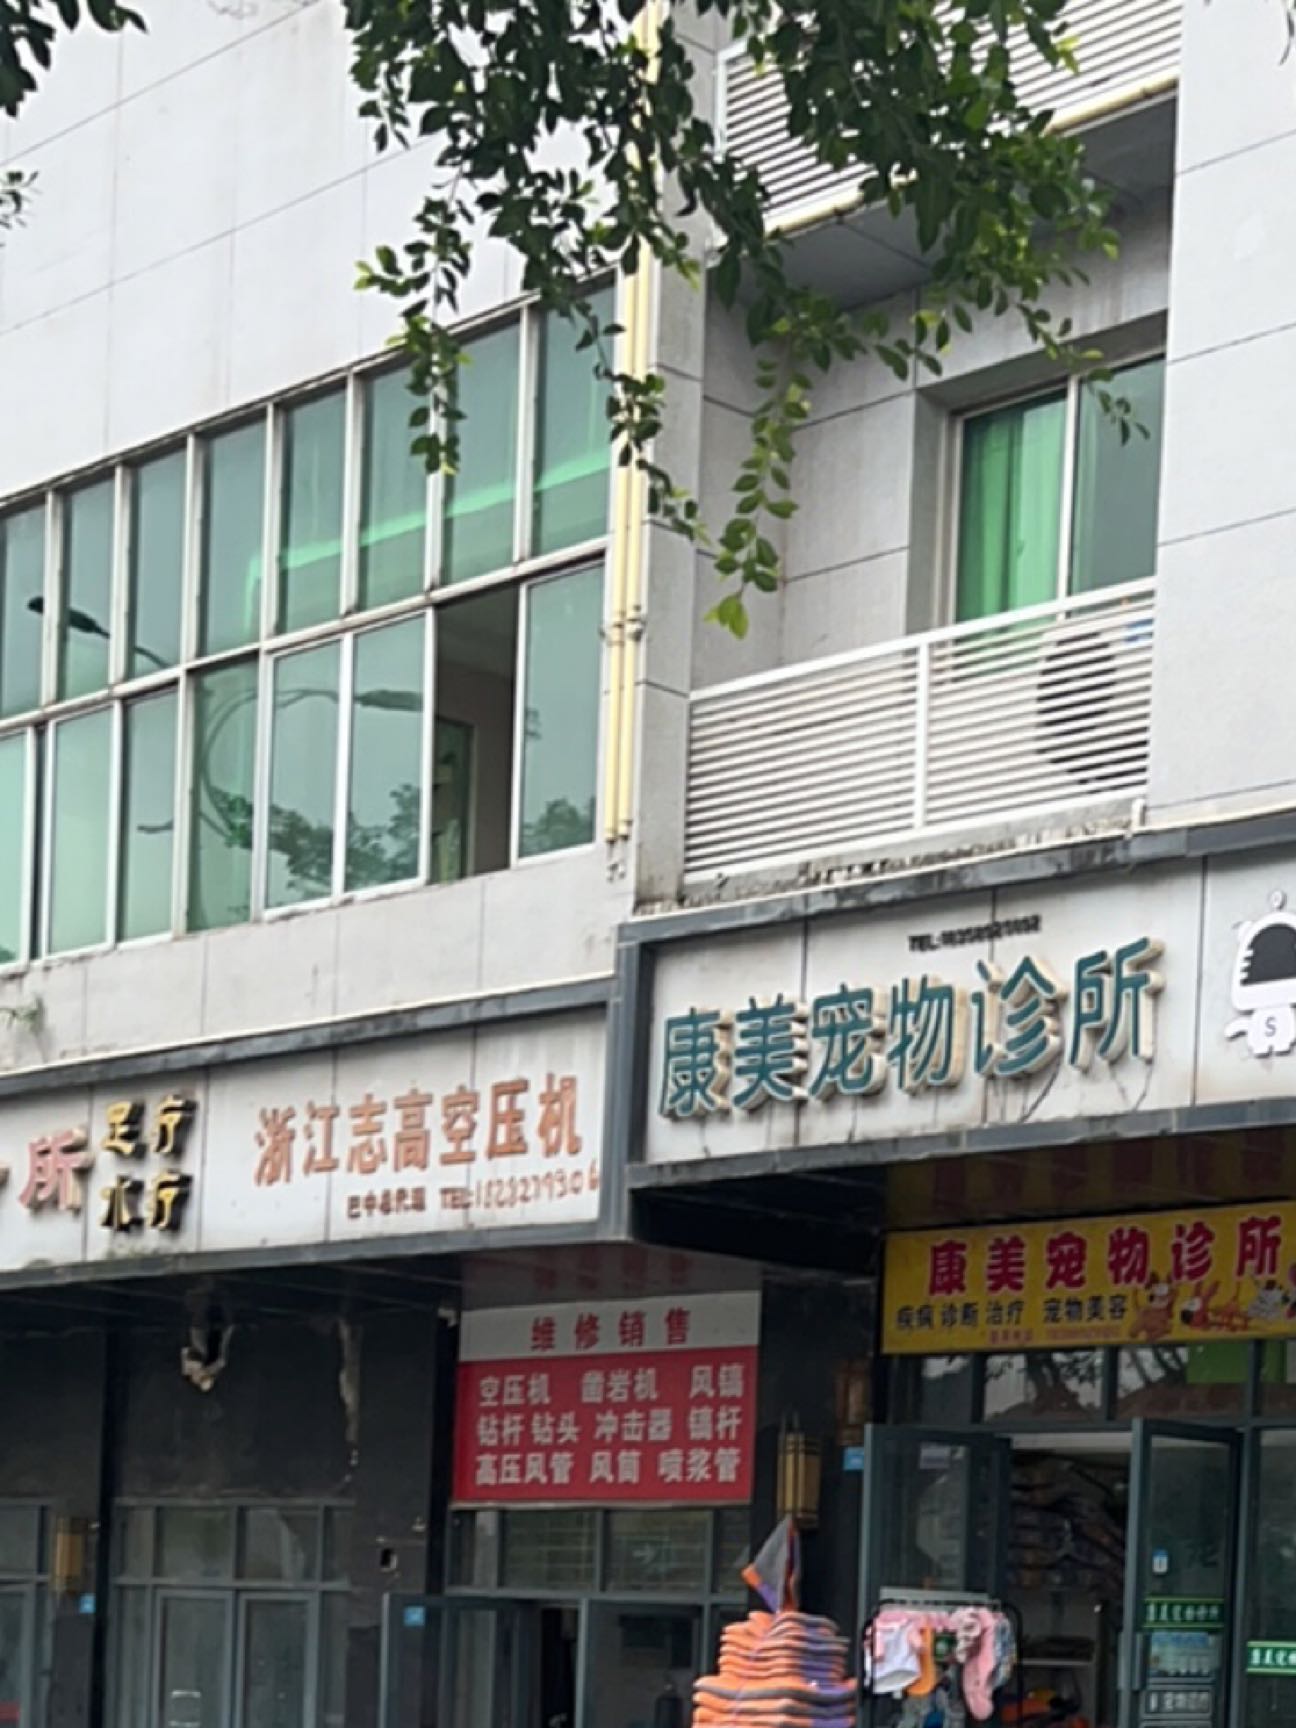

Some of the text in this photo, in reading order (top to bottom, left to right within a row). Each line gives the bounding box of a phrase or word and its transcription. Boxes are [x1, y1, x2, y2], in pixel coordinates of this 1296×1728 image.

[660, 936, 1165, 1120] 康美宠物诊所
[0, 1127, 94, 1214] 所
[254, 1074, 581, 1187] 浙江志高空压机
[929, 1215, 1283, 1296] 康美宠物诊所
[530, 1307, 691, 1352] 维修销售
[478, 1374, 551, 1408] 空压机
[475, 1453, 575, 1486] 高压风管
